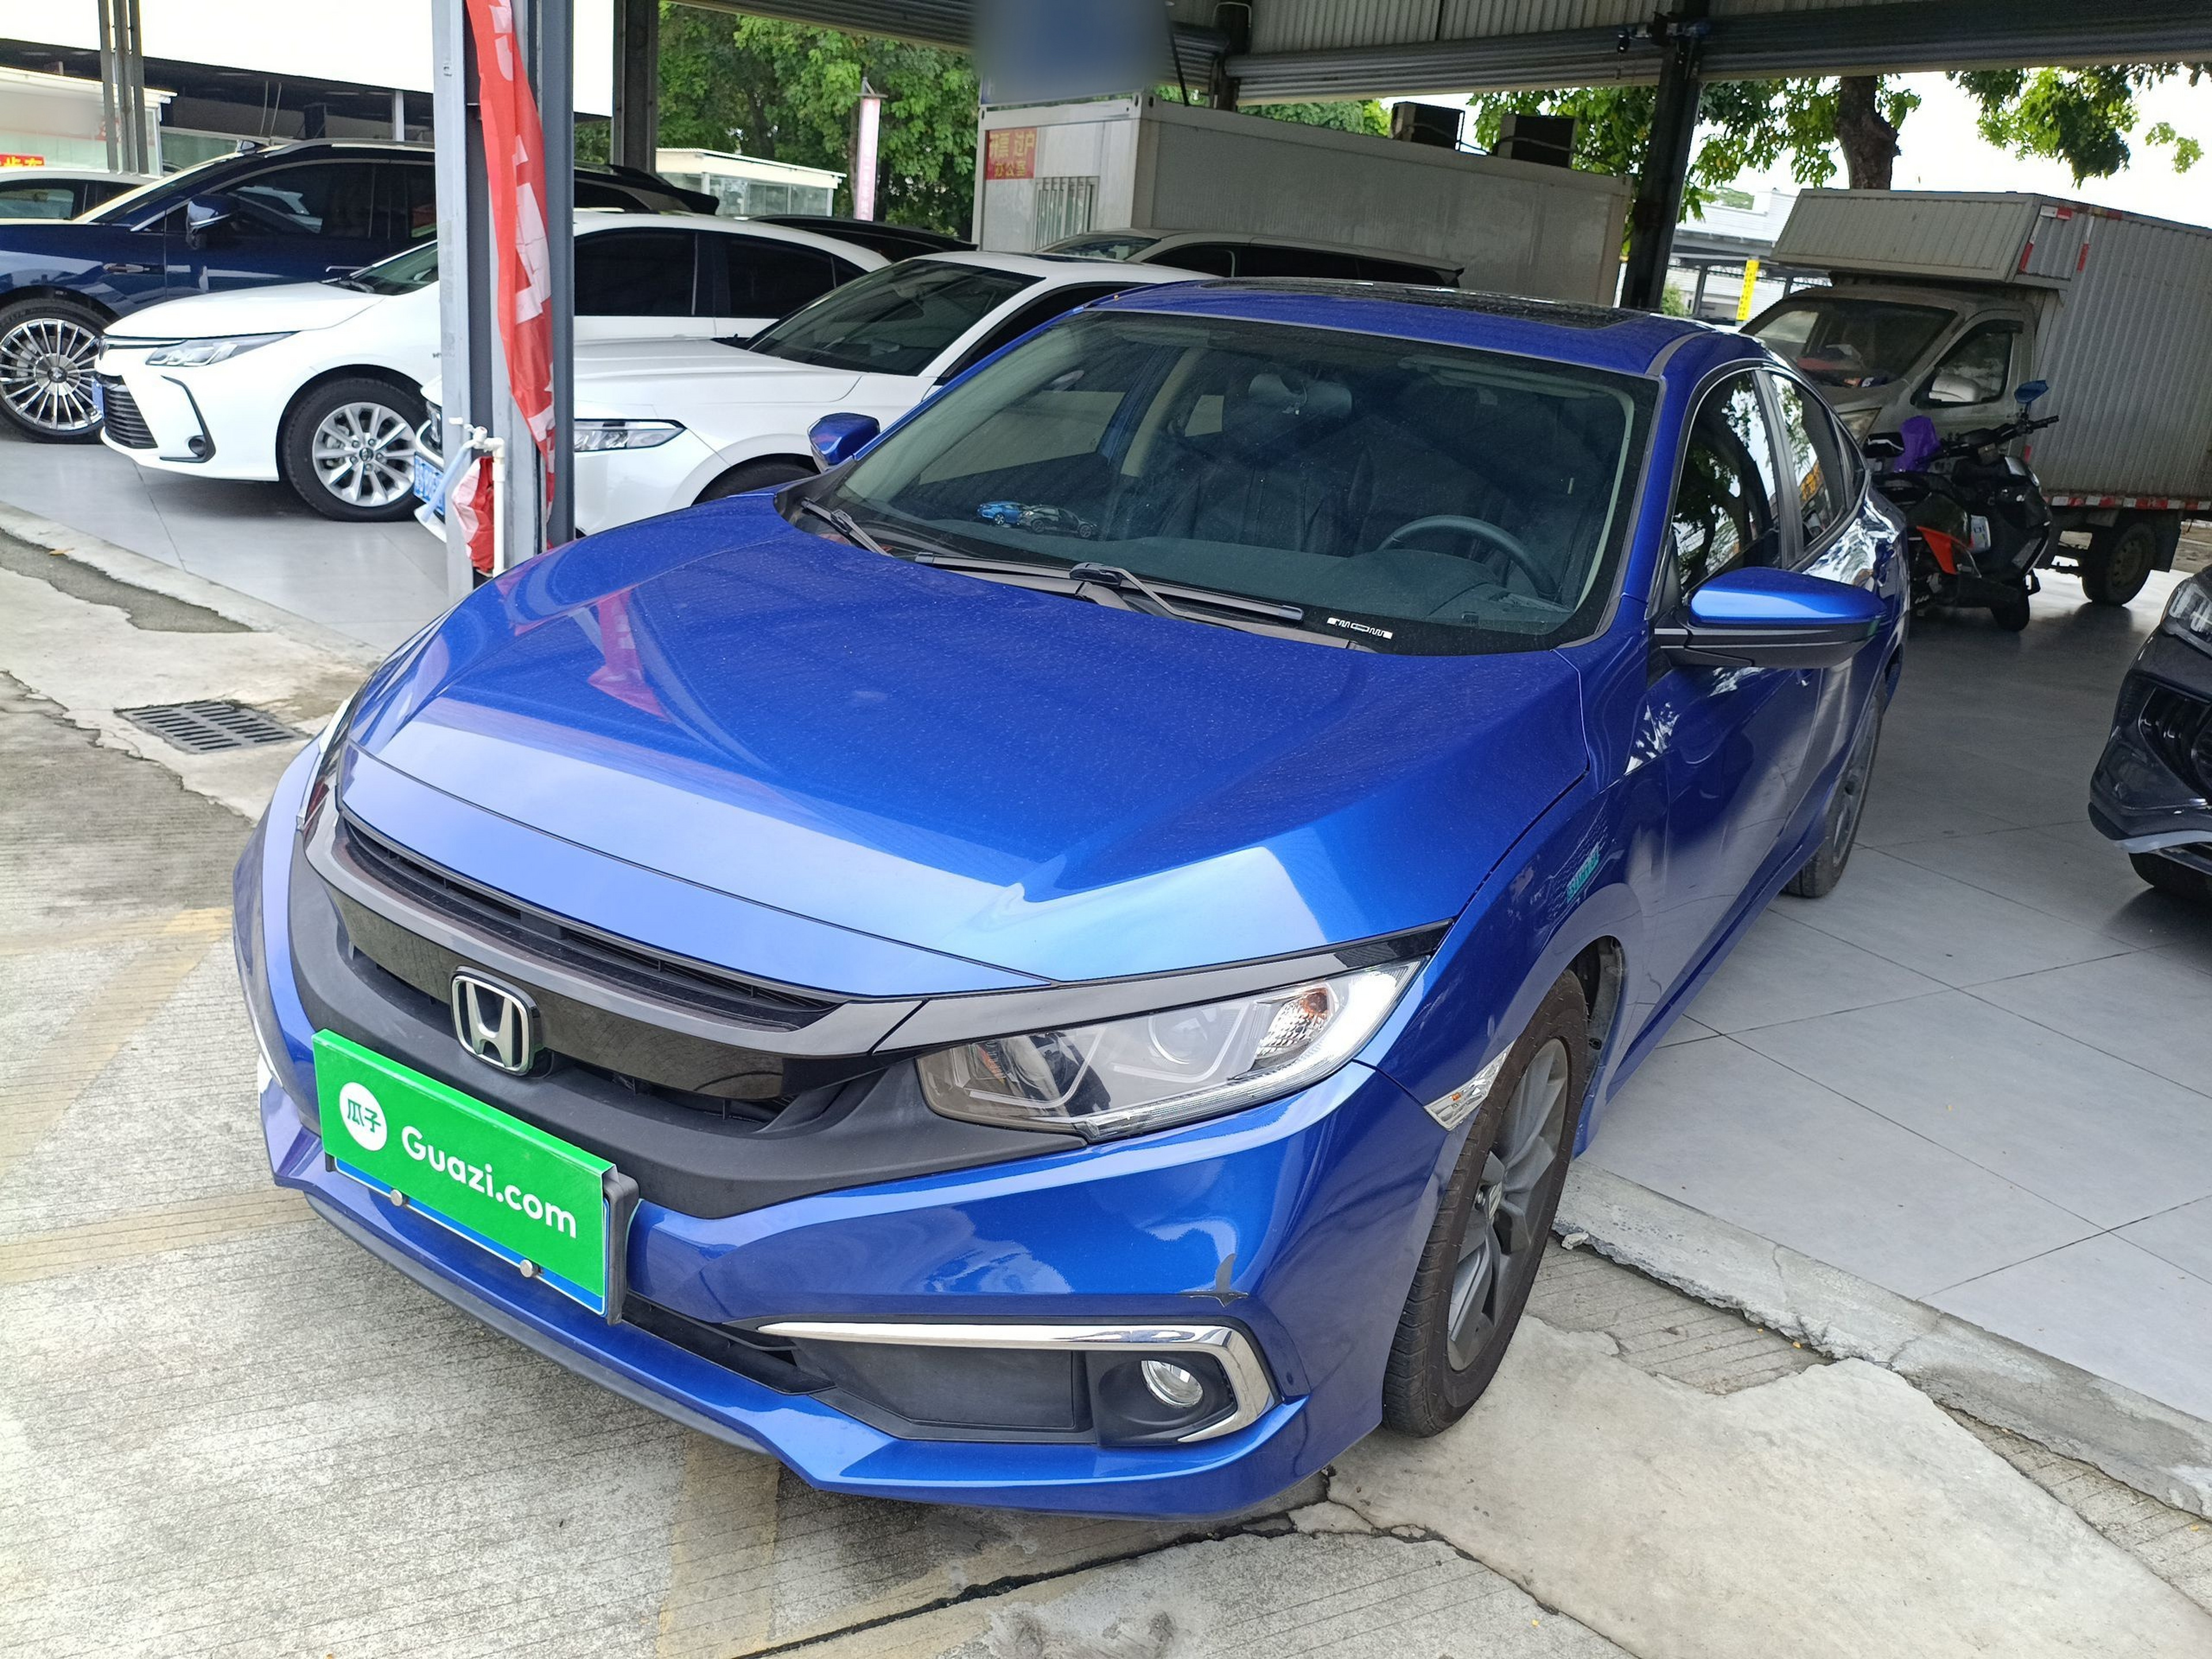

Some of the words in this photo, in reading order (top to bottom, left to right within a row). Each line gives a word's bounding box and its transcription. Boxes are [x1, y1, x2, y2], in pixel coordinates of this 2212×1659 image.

[995, 161, 1026, 177] 办公室
[347, 1099, 381, 1132] 瓜子
[401, 1125, 577, 1238] Guazi.com
